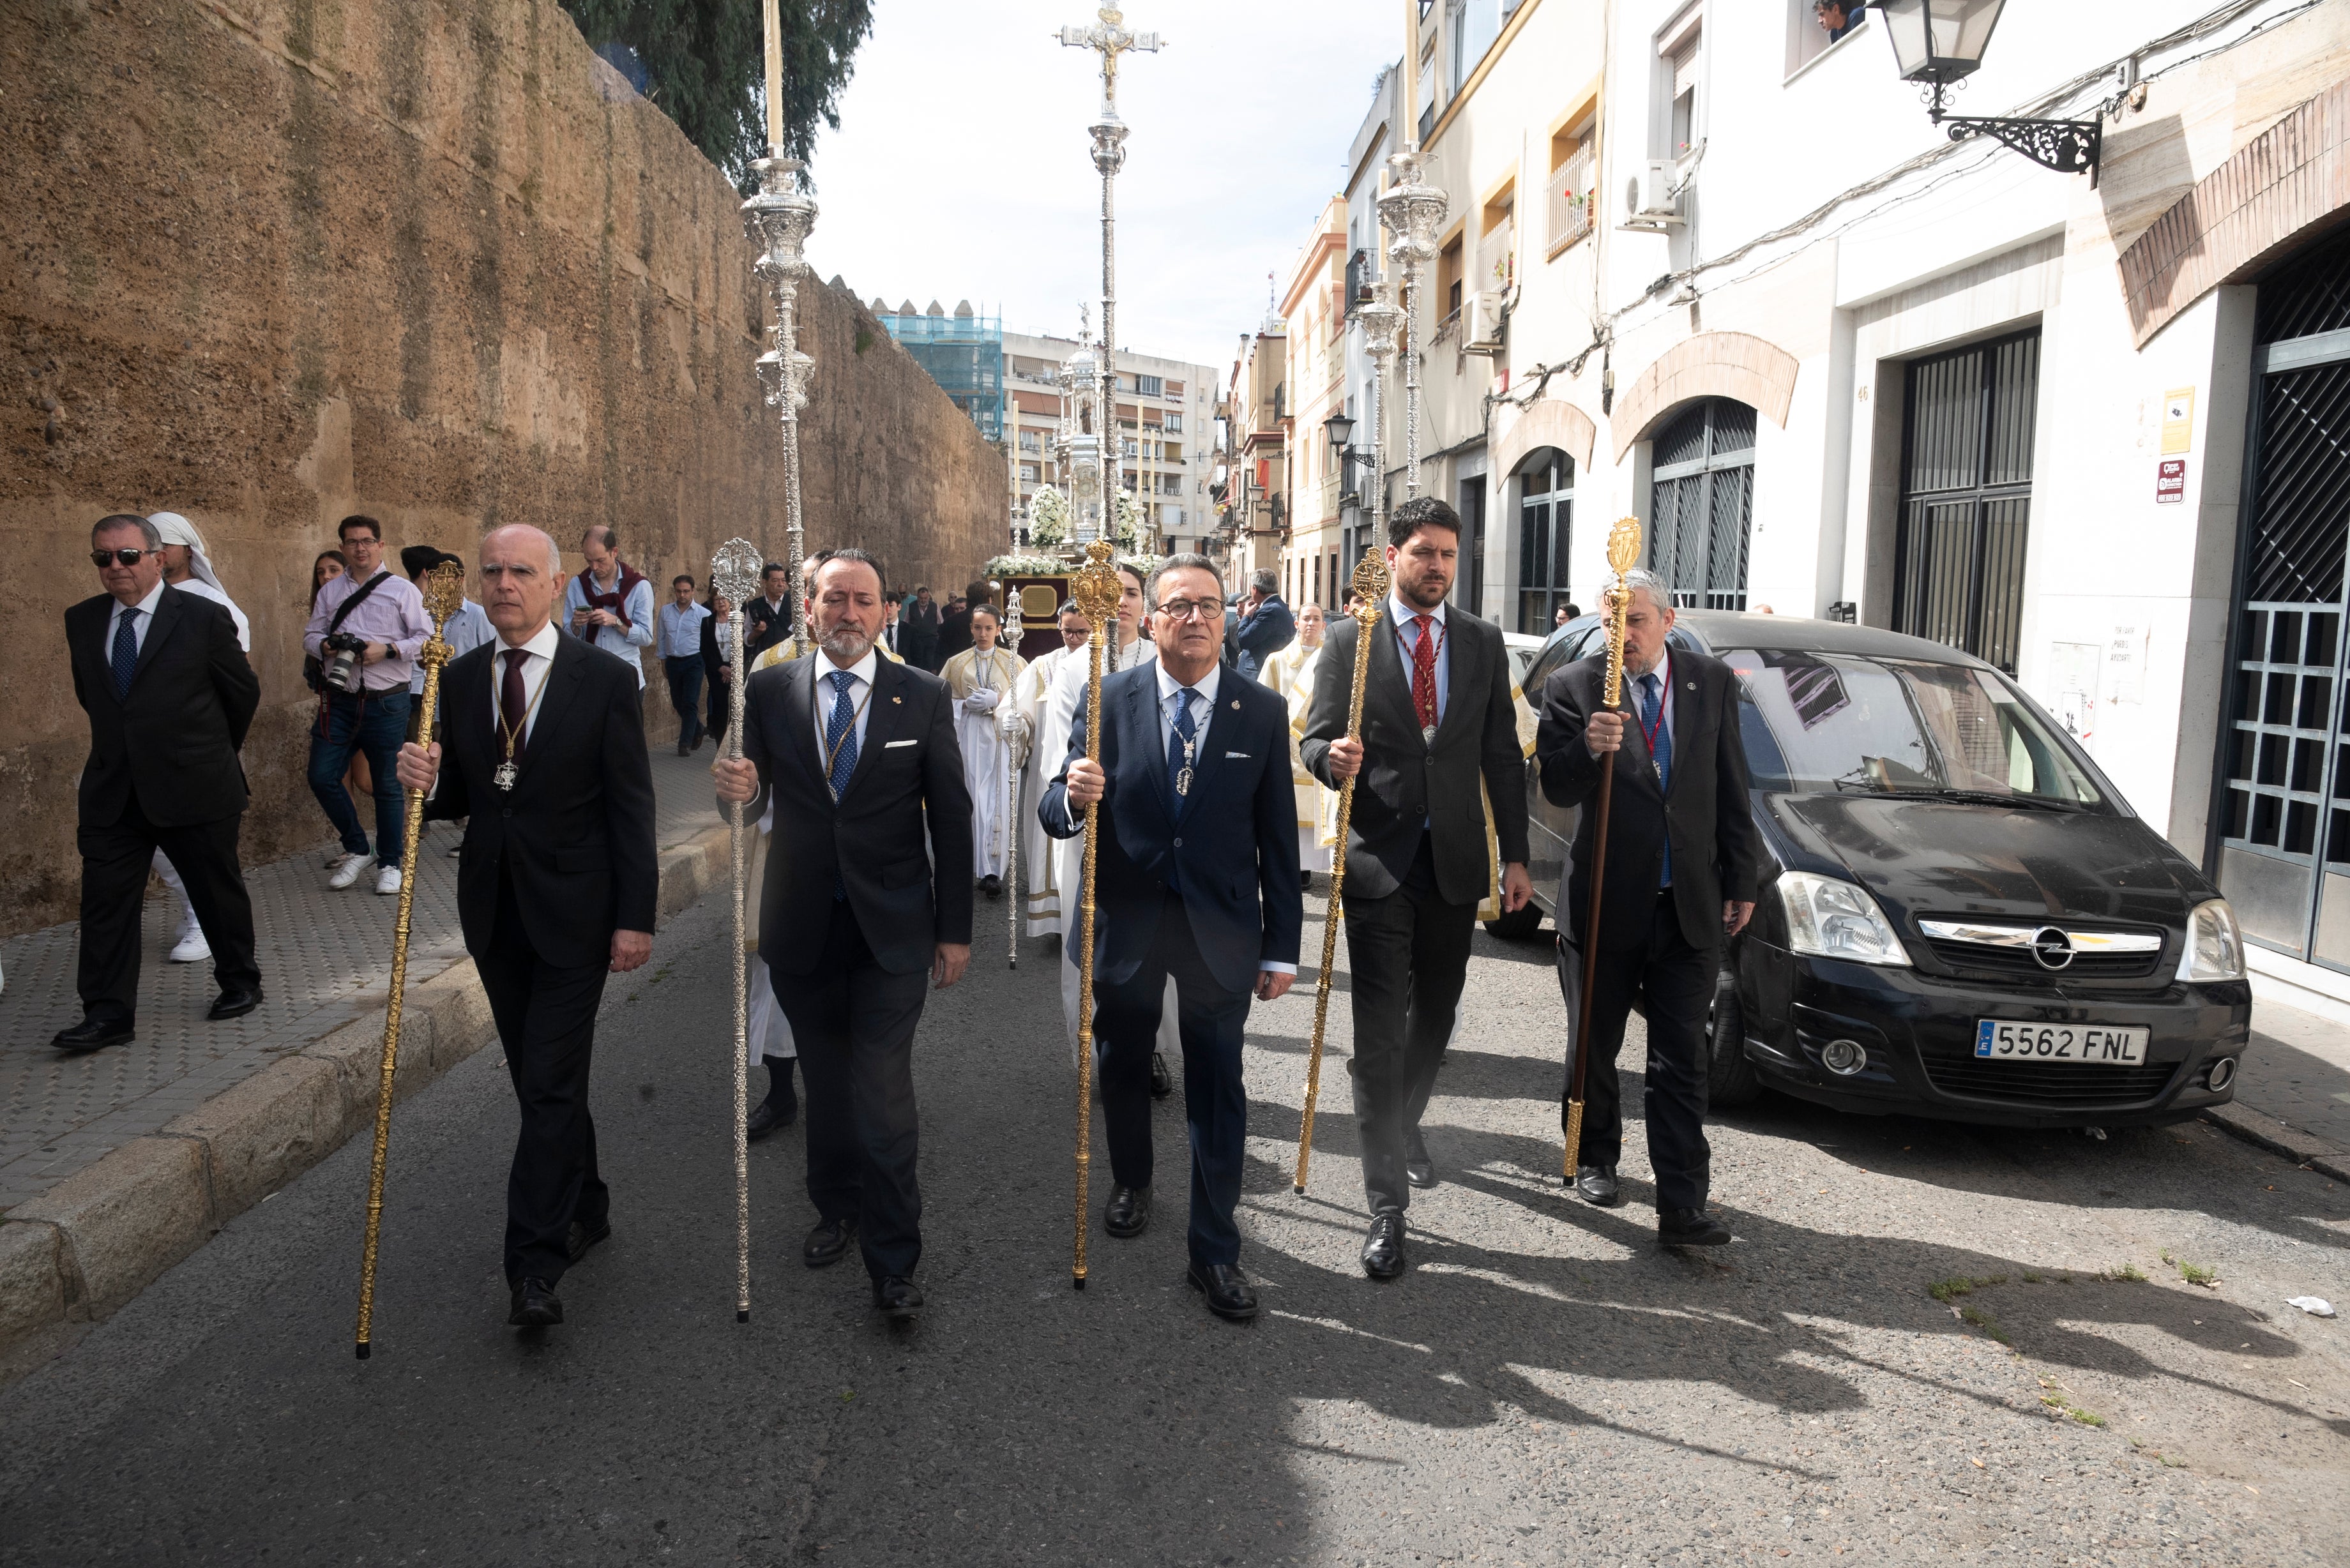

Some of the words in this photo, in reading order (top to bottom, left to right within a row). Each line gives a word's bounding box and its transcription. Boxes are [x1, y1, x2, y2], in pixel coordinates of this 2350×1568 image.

[1858, 386, 1868, 402] 46
[1998, 1026, 2073, 1057] 5562
[2082, 1031, 2136, 1060] FNL
